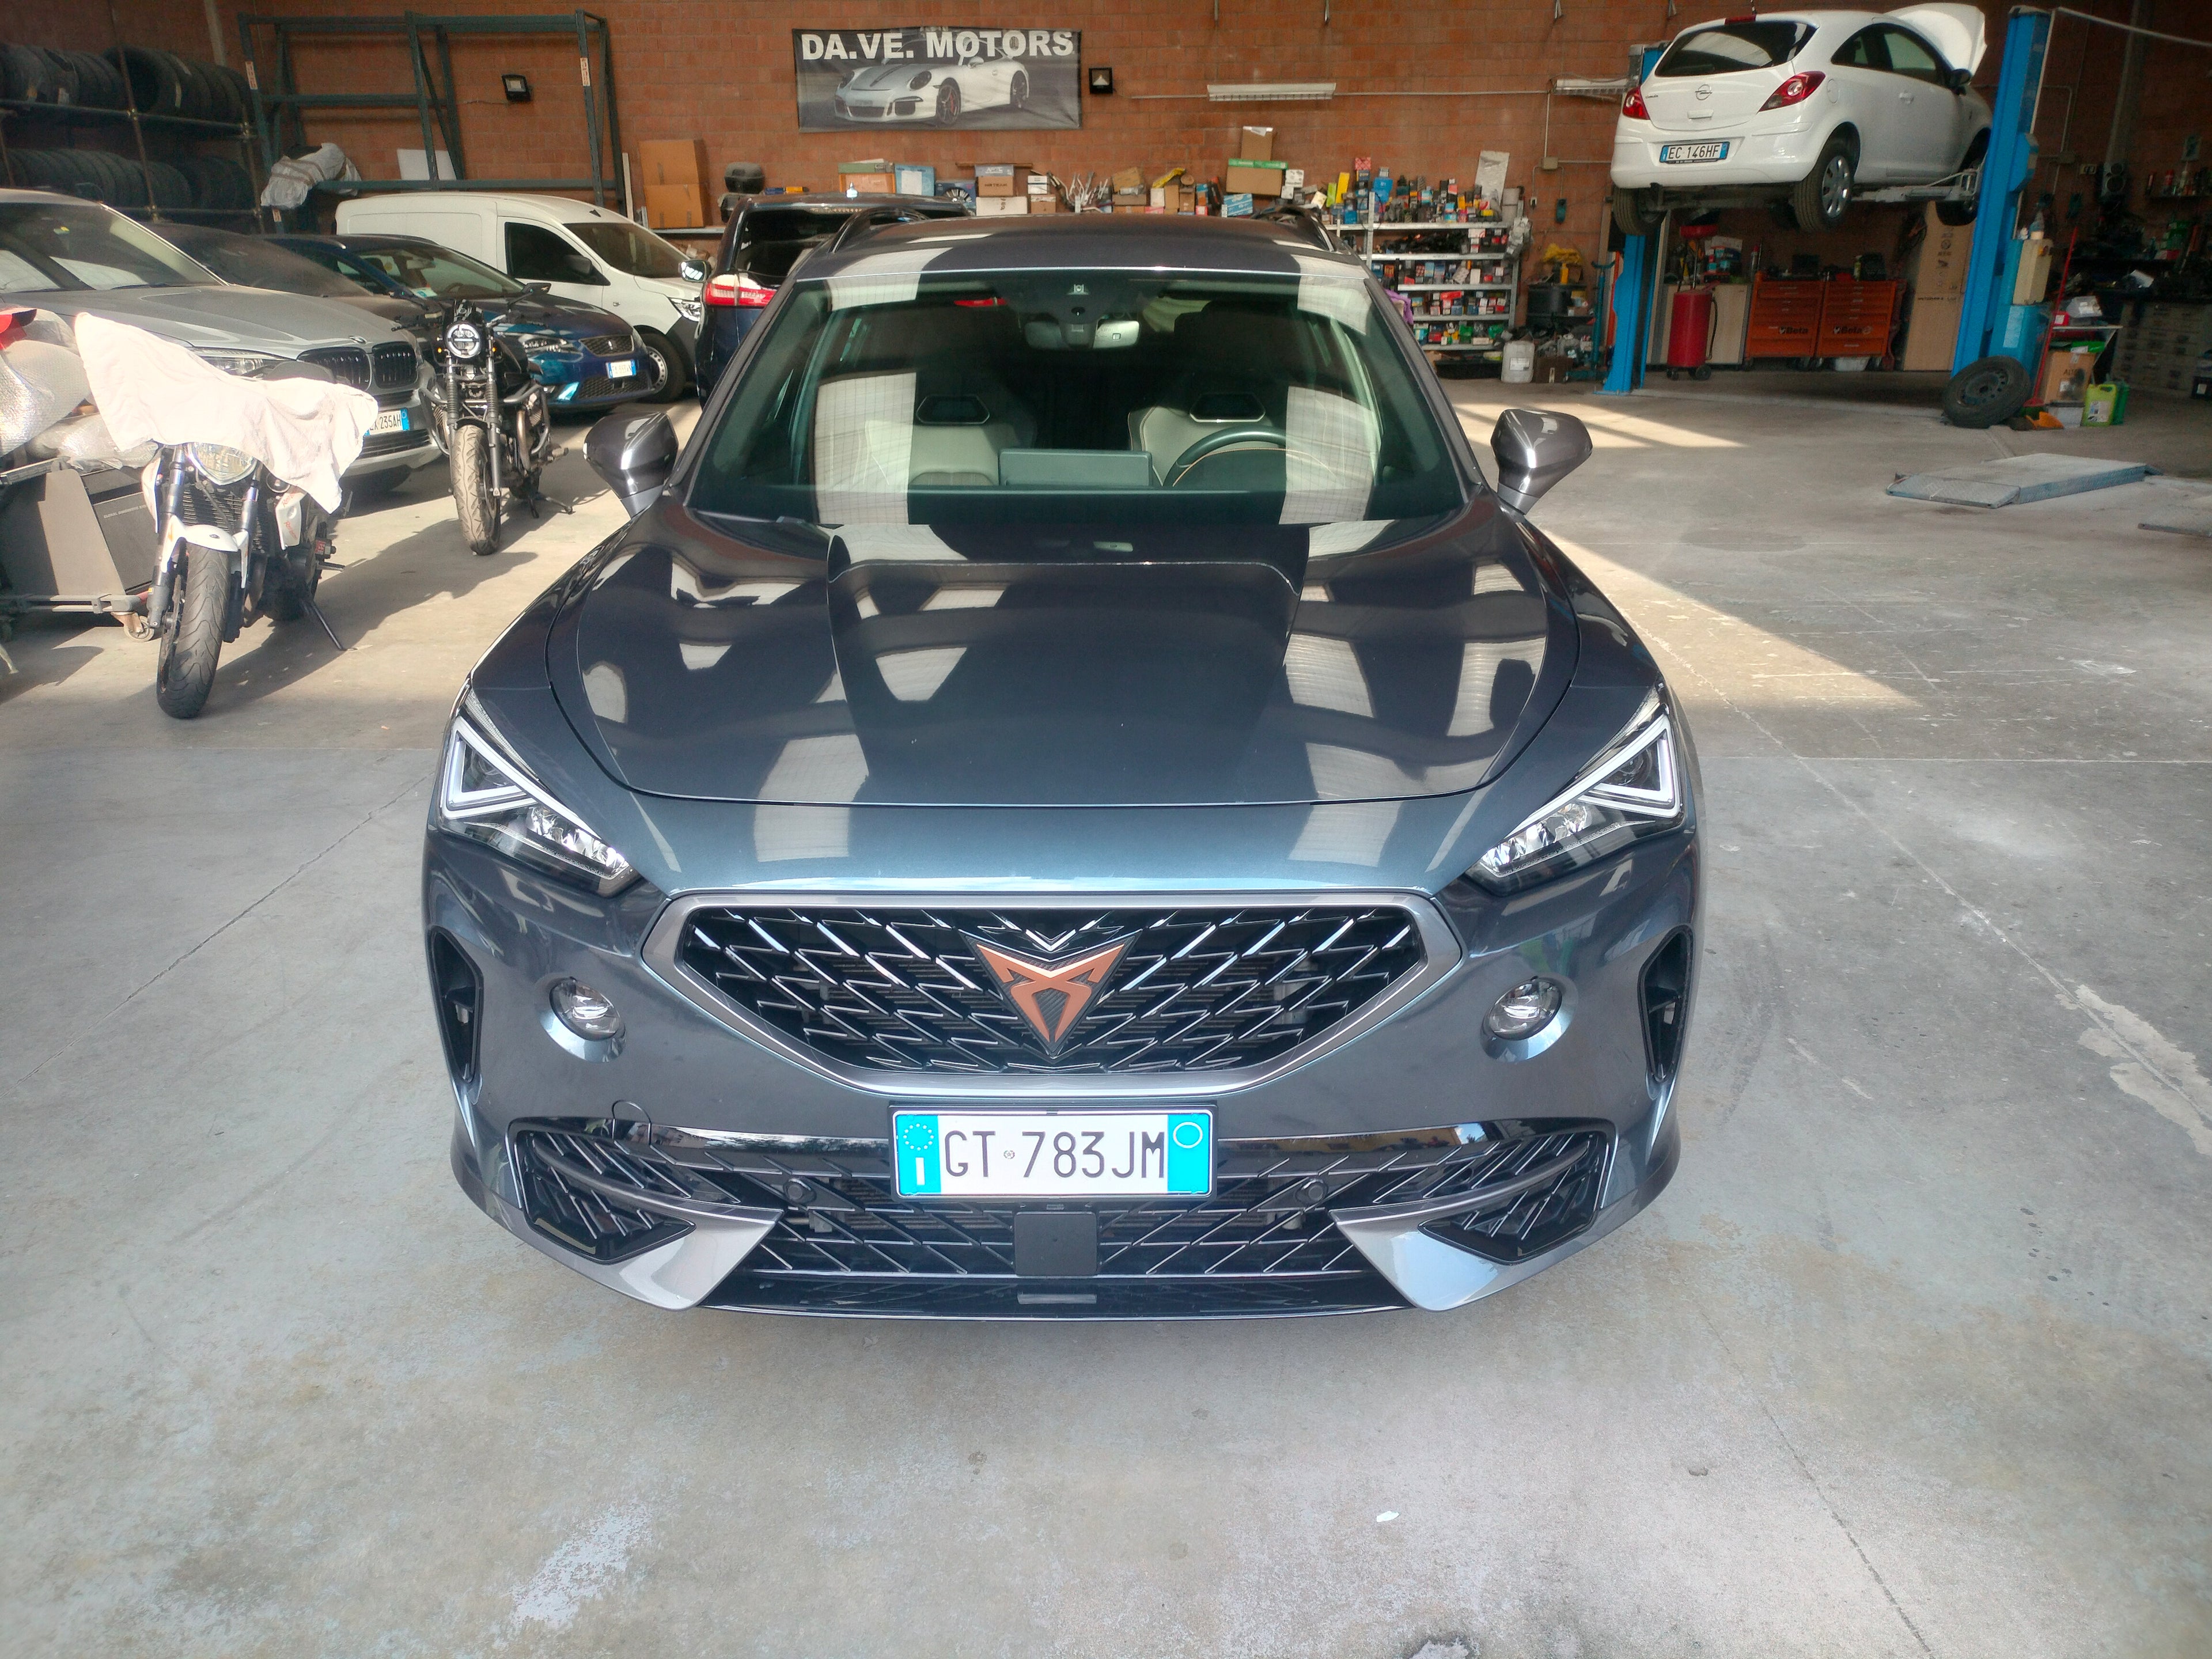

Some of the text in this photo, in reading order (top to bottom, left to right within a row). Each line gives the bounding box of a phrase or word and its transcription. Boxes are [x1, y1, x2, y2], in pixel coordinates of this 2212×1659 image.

[801, 31, 1074, 60] DA.VE. MOTORS
[1668, 145, 1720, 160] EC 146HF
[380, 413, 402, 430] 235AH
[944, 1130, 1165, 1179] GT 783JM
